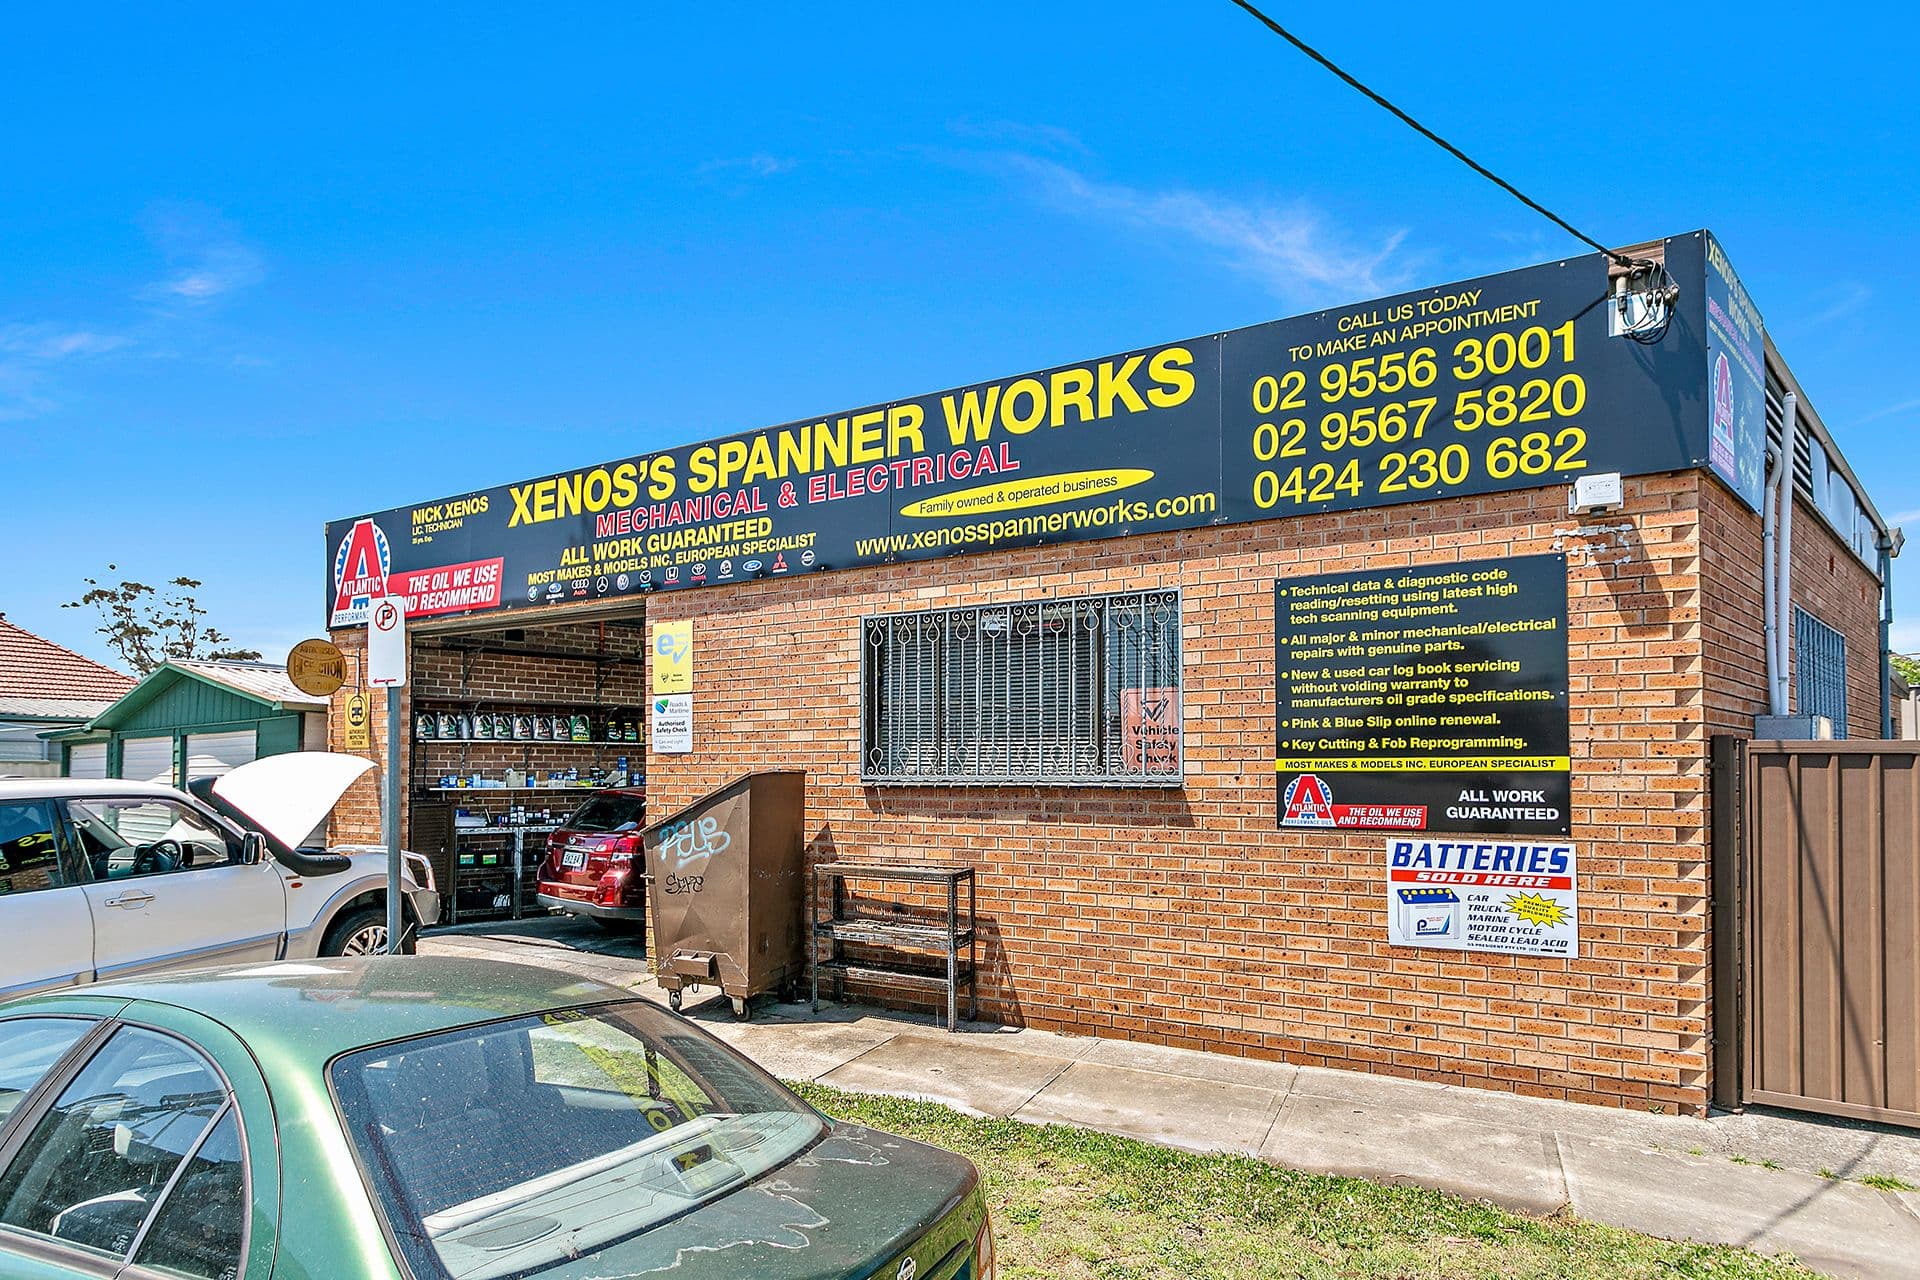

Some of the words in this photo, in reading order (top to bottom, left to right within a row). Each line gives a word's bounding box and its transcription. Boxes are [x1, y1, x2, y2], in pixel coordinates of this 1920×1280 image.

[1338, 311, 1383, 332] CALL
[1387, 304, 1413, 321] US
[1417, 289, 1482, 316] TODAY
[1288, 345, 1313, 361] TO
[1317, 334, 1366, 357] MAKE
[1370, 328, 1396, 348] AN
[1400, 300, 1541, 341] APPOINTMENT
[1252, 371, 1306, 414] 02
[1320, 347, 1437, 403] 9556
[1452, 320, 1575, 380] 3001
[1252, 419, 1307, 461] 02
[1320, 397, 1437, 451] 9567
[1453, 374, 1586, 432] 5820
[508, 455, 676, 528] XENOS'S
[687, 404, 925, 494] SPANNER
[941, 347, 1196, 446] WORKS
[1252, 459, 1364, 509] 0424
[1378, 444, 1469, 494] 230
[1486, 427, 1587, 479] 682
[596, 486, 767, 538] MECHANICAL
[778, 481, 798, 508] &
[808, 442, 1020, 504] ELECTRICAL
[919, 499, 954, 514] Family
[956, 493, 994, 509] owned
[996, 490, 1005, 503] &
[1007, 482, 1060, 503] operated
[1062, 473, 1118, 493] business
[412, 505, 443, 525] NICK
[445, 496, 489, 518] XENOS
[425, 518, 463, 533] TECHNICIAN
[855, 491, 1216, 556] www.xenosspannerworks.com
[560, 546, 590, 567] ALL
[593, 538, 642, 559] WORK
[647, 516, 772, 551] GUARANTEED
[528, 571, 556, 585] MOST
[557, 565, 592, 581] MAKES
[593, 565, 602, 575] &
[603, 557, 648, 574] MODELS
[650, 554, 673, 568] INC.
[676, 545, 739, 565] EUROPEAN
[742, 533, 816, 555] SPECIALIST
[343, 576, 381, 597] ATLANTIC
[408, 574, 430, 593] THE
[431, 572, 450, 590] OIL
[453, 568, 472, 587] WE
[473, 564, 499, 584] USE
[1290, 582, 1349, 598] Technical
[1352, 580, 1381, 593] data
[1384, 578, 1395, 590] &
[1397, 572, 1469, 591] diagnostic
[1471, 568, 1508, 582] code
[404, 596, 418, 612] ND
[420, 584, 495, 610] RECOMMEND
[1290, 592, 1399, 611] reading/resetting
[1402, 590, 1440, 604] using
[1442, 584, 1483, 599] latest
[1486, 583, 1518, 597] high
[334, 609, 370, 623] PERFORMANC
[1290, 613, 1318, 625] tech
[1320, 607, 1379, 623] scanning
[1381, 603, 1458, 619] equipment.
[1290, 634, 1307, 646] All
[1309, 632, 1346, 646] major
[1348, 631, 1359, 642] &
[1361, 628, 1401, 641] minor
[1403, 618, 1557, 639] mechanical/electrical
[1290, 647, 1334, 661] repairs
[1337, 644, 1365, 657] with
[1367, 641, 1421, 657] genuine
[1425, 639, 1465, 653] parts.
[1291, 668, 1320, 680] New
[1321, 668, 1332, 679] &
[1334, 665, 1366, 678] used
[1368, 666, 1391, 677] car
[1393, 664, 1414, 678] log
[1417, 662, 1452, 675] book
[1454, 659, 1520, 674] servicing
[1291, 682, 1338, 695] without
[1340, 680, 1388, 693] voiding
[1390, 678, 1452, 692] warranty
[1454, 677, 1469, 688] to
[1291, 695, 1384, 708] manufacturers
[1386, 694, 1403, 705] oil
[1406, 692, 1446, 707] grade
[1448, 689, 1555, 704] specifications.
[1132, 725, 1179, 735] Vehicle
[1291, 717, 1319, 729] Pink
[1321, 717, 1332, 728] &
[1335, 715, 1364, 728] Blue
[1366, 714, 1392, 729] Slip
[1394, 714, 1438, 727] online
[1439, 713, 1501, 726] renewal.
[1291, 739, 1316, 752] Key
[1318, 737, 1365, 751] Cutting
[1368, 737, 1379, 749] &
[1382, 737, 1407, 749] Fob
[1410, 735, 1528, 750] Reprogramming.
[1285, 760, 1313, 769] MOST
[1314, 760, 1349, 769] MAKES
[1351, 760, 1359, 769] &
[1360, 760, 1404, 769] MODELS
[1405, 760, 1426, 769] INC.
[1429, 759, 1489, 769] EUROPEAN
[1490, 759, 1556, 768] SPECIALIST
[1458, 790, 1489, 802] ALL
[1492, 790, 1545, 803] WORK
[1291, 803, 1325, 813] ATLANTIC
[1349, 807, 1368, 816] THE
[1369, 808, 1384, 816] OIL
[1386, 808, 1402, 817] WE
[1404, 808, 1423, 817] USE
[1445, 807, 1559, 821] GUARANTEED
[1338, 816, 1358, 825] AND
[1360, 817, 1421, 826] RECOMMEND
[1392, 842, 1570, 874] BATTERIES
[1416, 871, 1481, 885] SOLD
[1483, 874, 1552, 887] HERE
[1467, 894, 1489, 902] CAR
[1468, 904, 1502, 913] TRUCK
[1523, 900, 1551, 909] PREMIUM
[1467, 914, 1510, 923] MARINE
[1467, 924, 1506, 933] MOTOR
[1509, 926, 1543, 936] CYCLE
[1467, 933, 1509, 943] SEALED
[1510, 937, 1539, 946] LEAD
[1541, 939, 1569, 947] ACID
